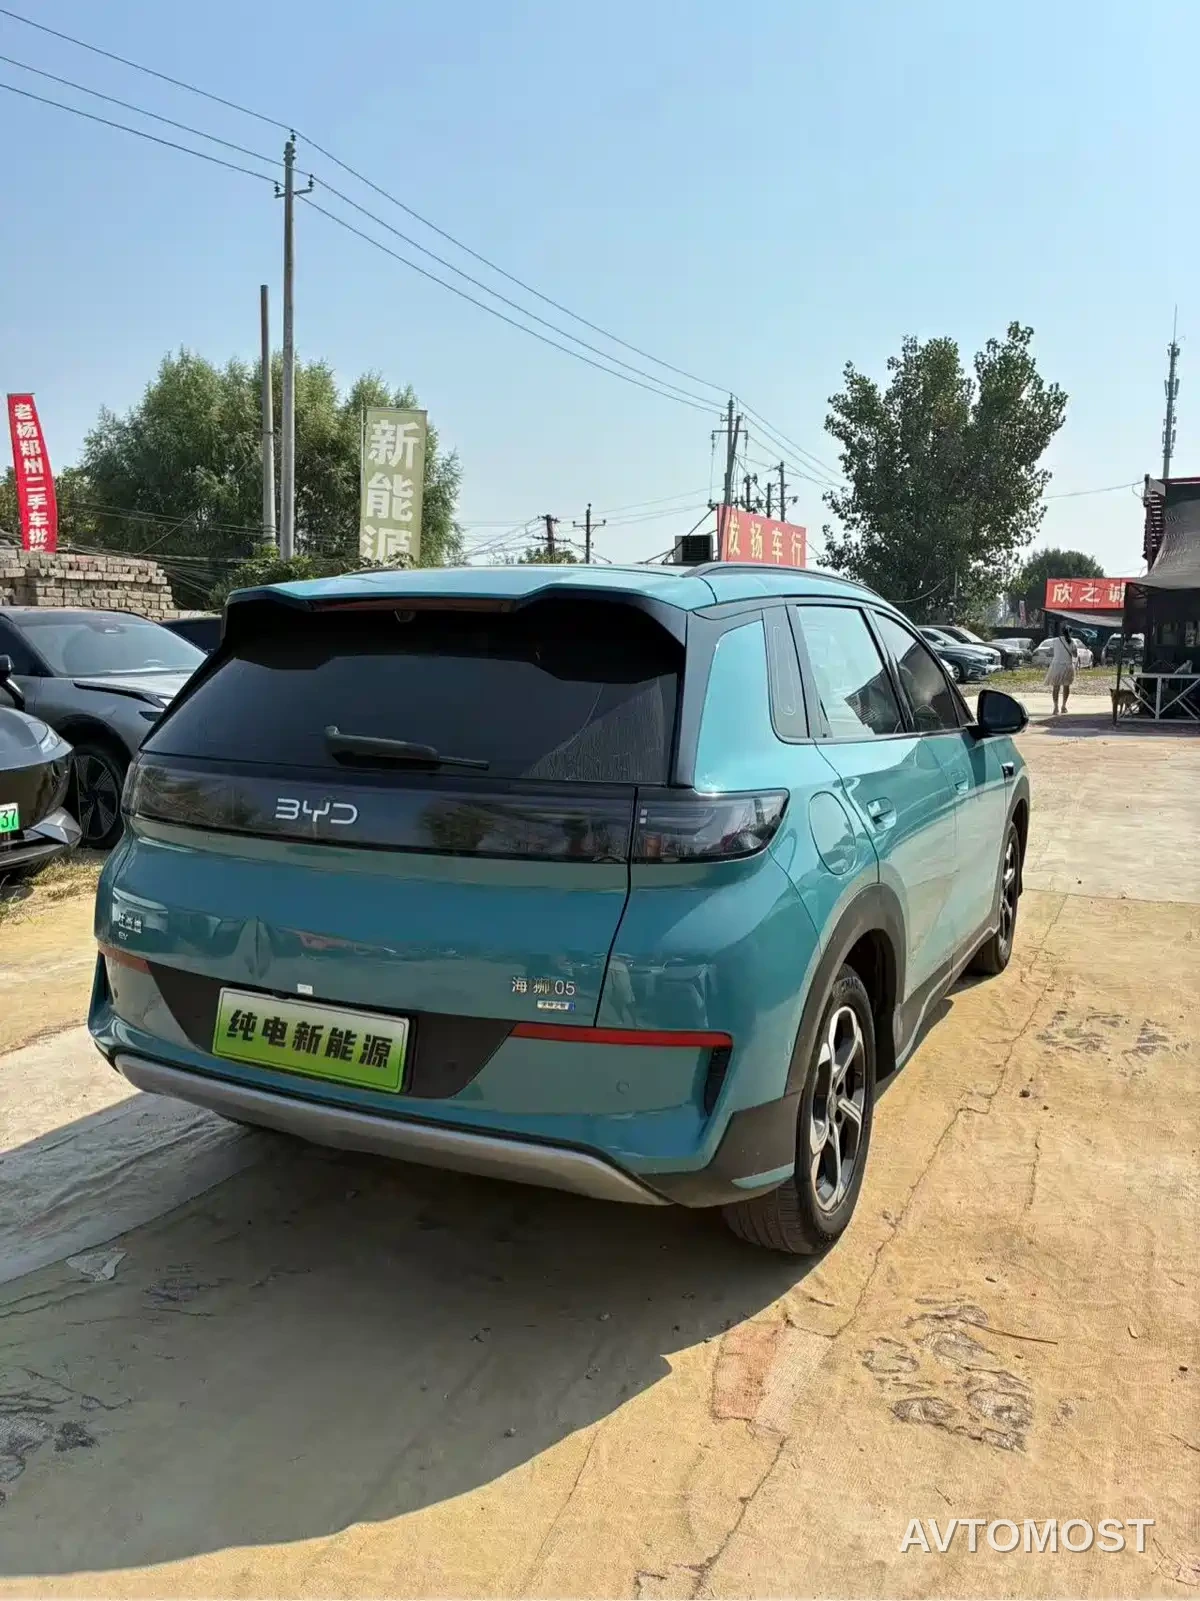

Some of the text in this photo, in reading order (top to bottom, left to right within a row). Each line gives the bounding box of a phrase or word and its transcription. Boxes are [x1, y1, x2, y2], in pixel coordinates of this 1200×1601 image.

[361, 419, 420, 566] 新能源
[275, 797, 359, 825] BYD
[226, 1008, 394, 1069] 纯电新能源
